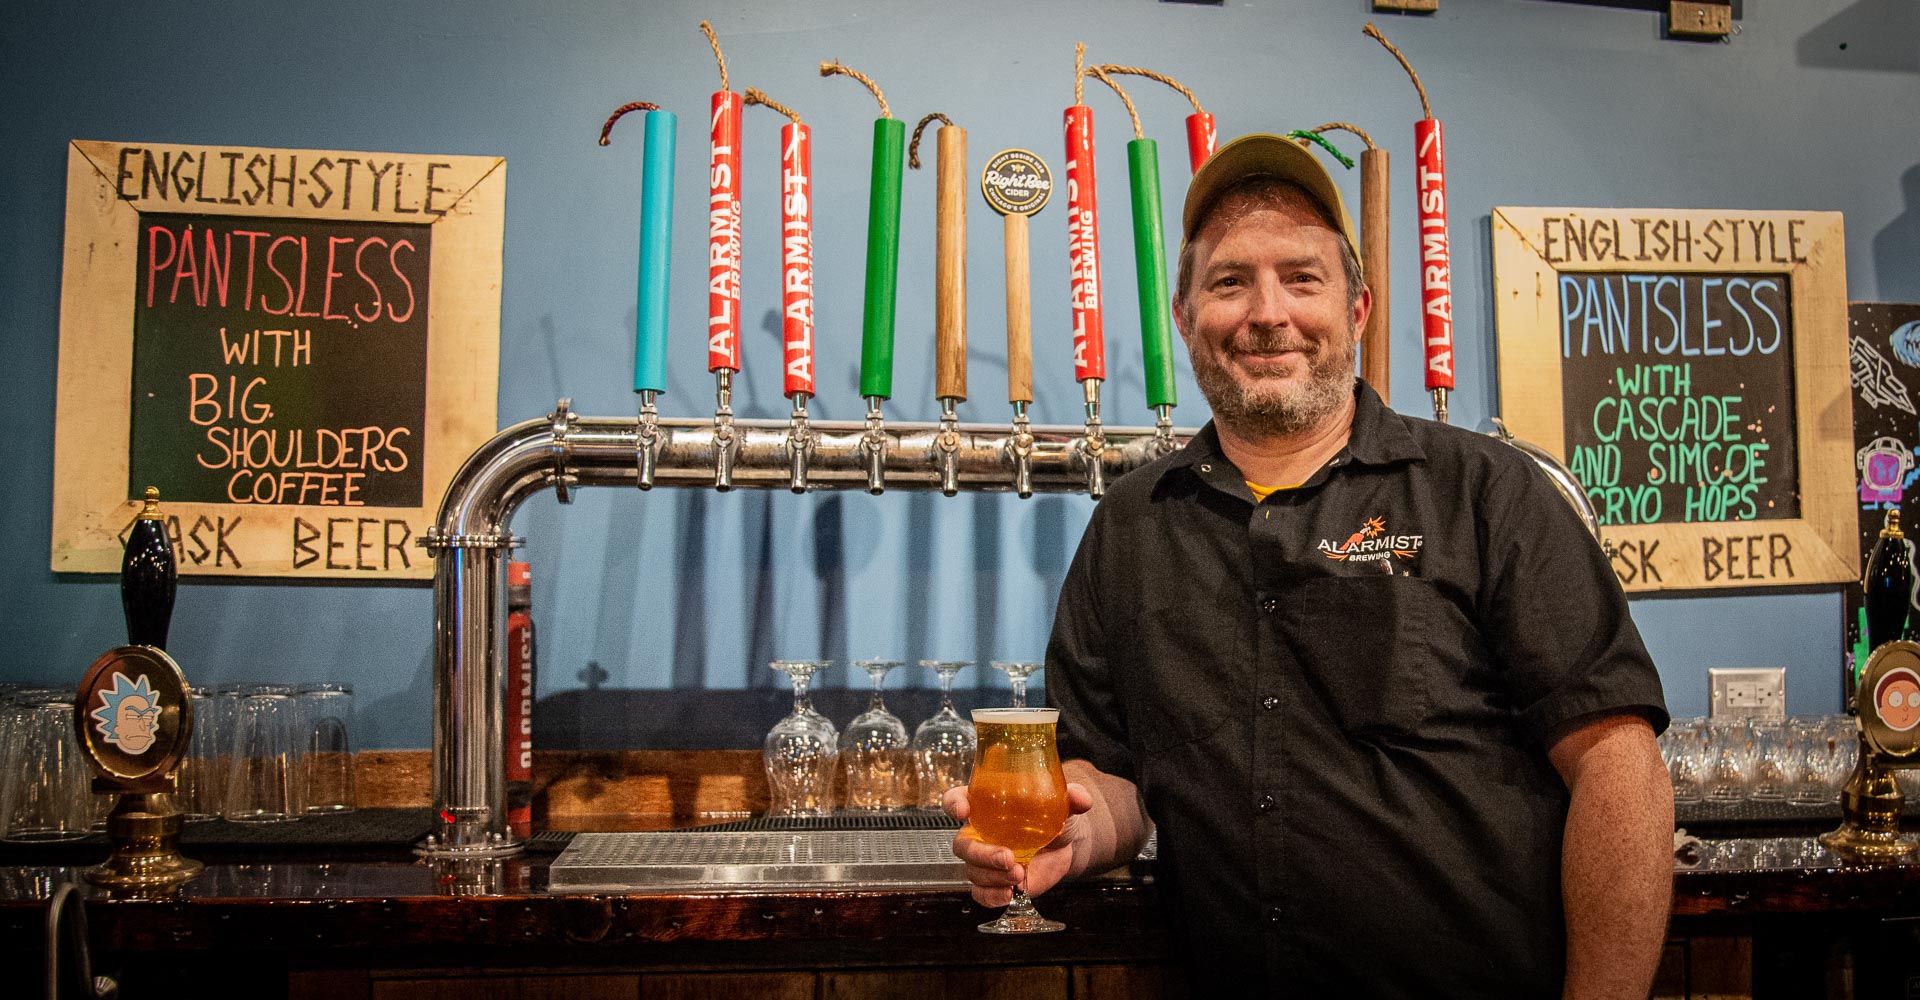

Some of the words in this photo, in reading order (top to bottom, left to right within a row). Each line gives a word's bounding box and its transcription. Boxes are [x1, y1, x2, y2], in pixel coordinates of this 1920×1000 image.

[117, 148, 452, 216] ENGLISH-STYLE
[1004, 188, 1029, 197] CIDER
[1019, 192, 1046, 211] ORIGINAL
[709, 141, 732, 358] ALARMIST
[730, 201, 741, 300] BREWING
[1081, 210, 1098, 310] BREWING
[1543, 217, 1809, 264] ENGLISH-STYLE
[147, 226, 415, 324] PANTSLESS
[784, 169, 812, 383] ALARMIST
[1420, 165, 1452, 377] ALARMIST
[1559, 275, 1781, 358] PANTSLESS
[220, 328, 311, 367] WITH
[1616, 363, 1691, 396] WITH
[1593, 396, 1743, 442] CASCADE
[197, 427, 411, 472] SHOULDERS
[1570, 443, 1621, 487] AND
[1647, 442, 1770, 486] SIMCOE
[228, 470, 366, 506] COFFEE
[1685, 483, 1759, 523] HOPS
[293, 517, 412, 570] BEER
[1317, 535, 1422, 553] ALARMIST
[1349, 551, 1390, 561] BREWING
[1616, 539, 1662, 584] SK
[1703, 533, 1796, 582] BEER
